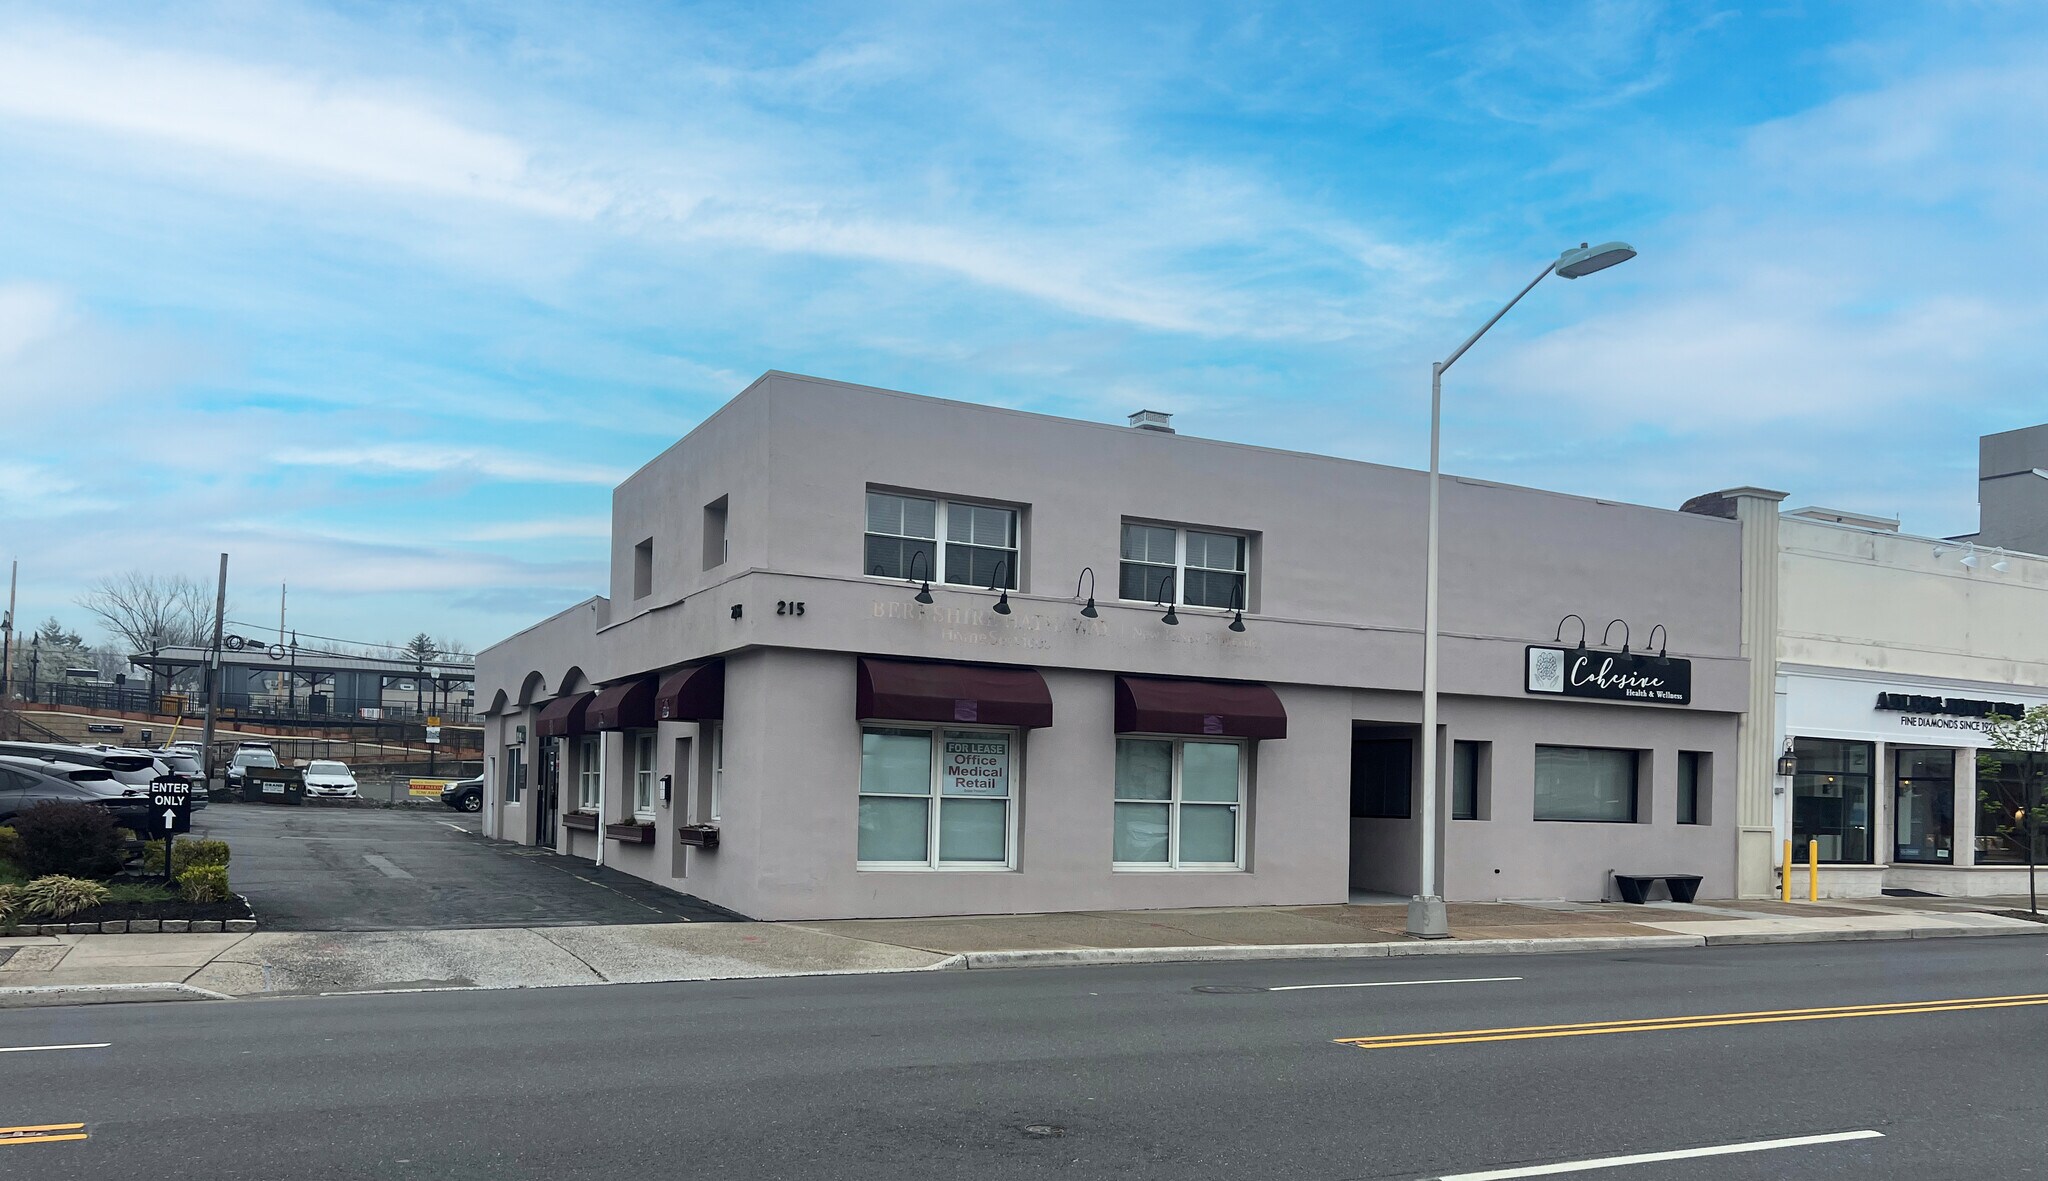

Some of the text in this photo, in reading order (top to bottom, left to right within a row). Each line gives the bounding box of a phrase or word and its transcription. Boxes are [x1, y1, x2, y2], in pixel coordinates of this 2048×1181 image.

[776, 600, 805, 616] 215
[1570, 656, 1665, 689] Cohesive
[1625, 688, 1683, 700] Health & Wellness
[1900, 716, 1917, 727] FINE
[1917, 717, 1958, 730] DIAMONDS
[1959, 720, 1981, 731] SINCE
[948, 743, 1003, 754] FOR LEASE
[954, 754, 997, 766] Office
[948, 765, 1003, 777] Medical
[151, 782, 189, 793] ENTER
[955, 777, 995, 789] Retail
[154, 795, 185, 806] ONLY
